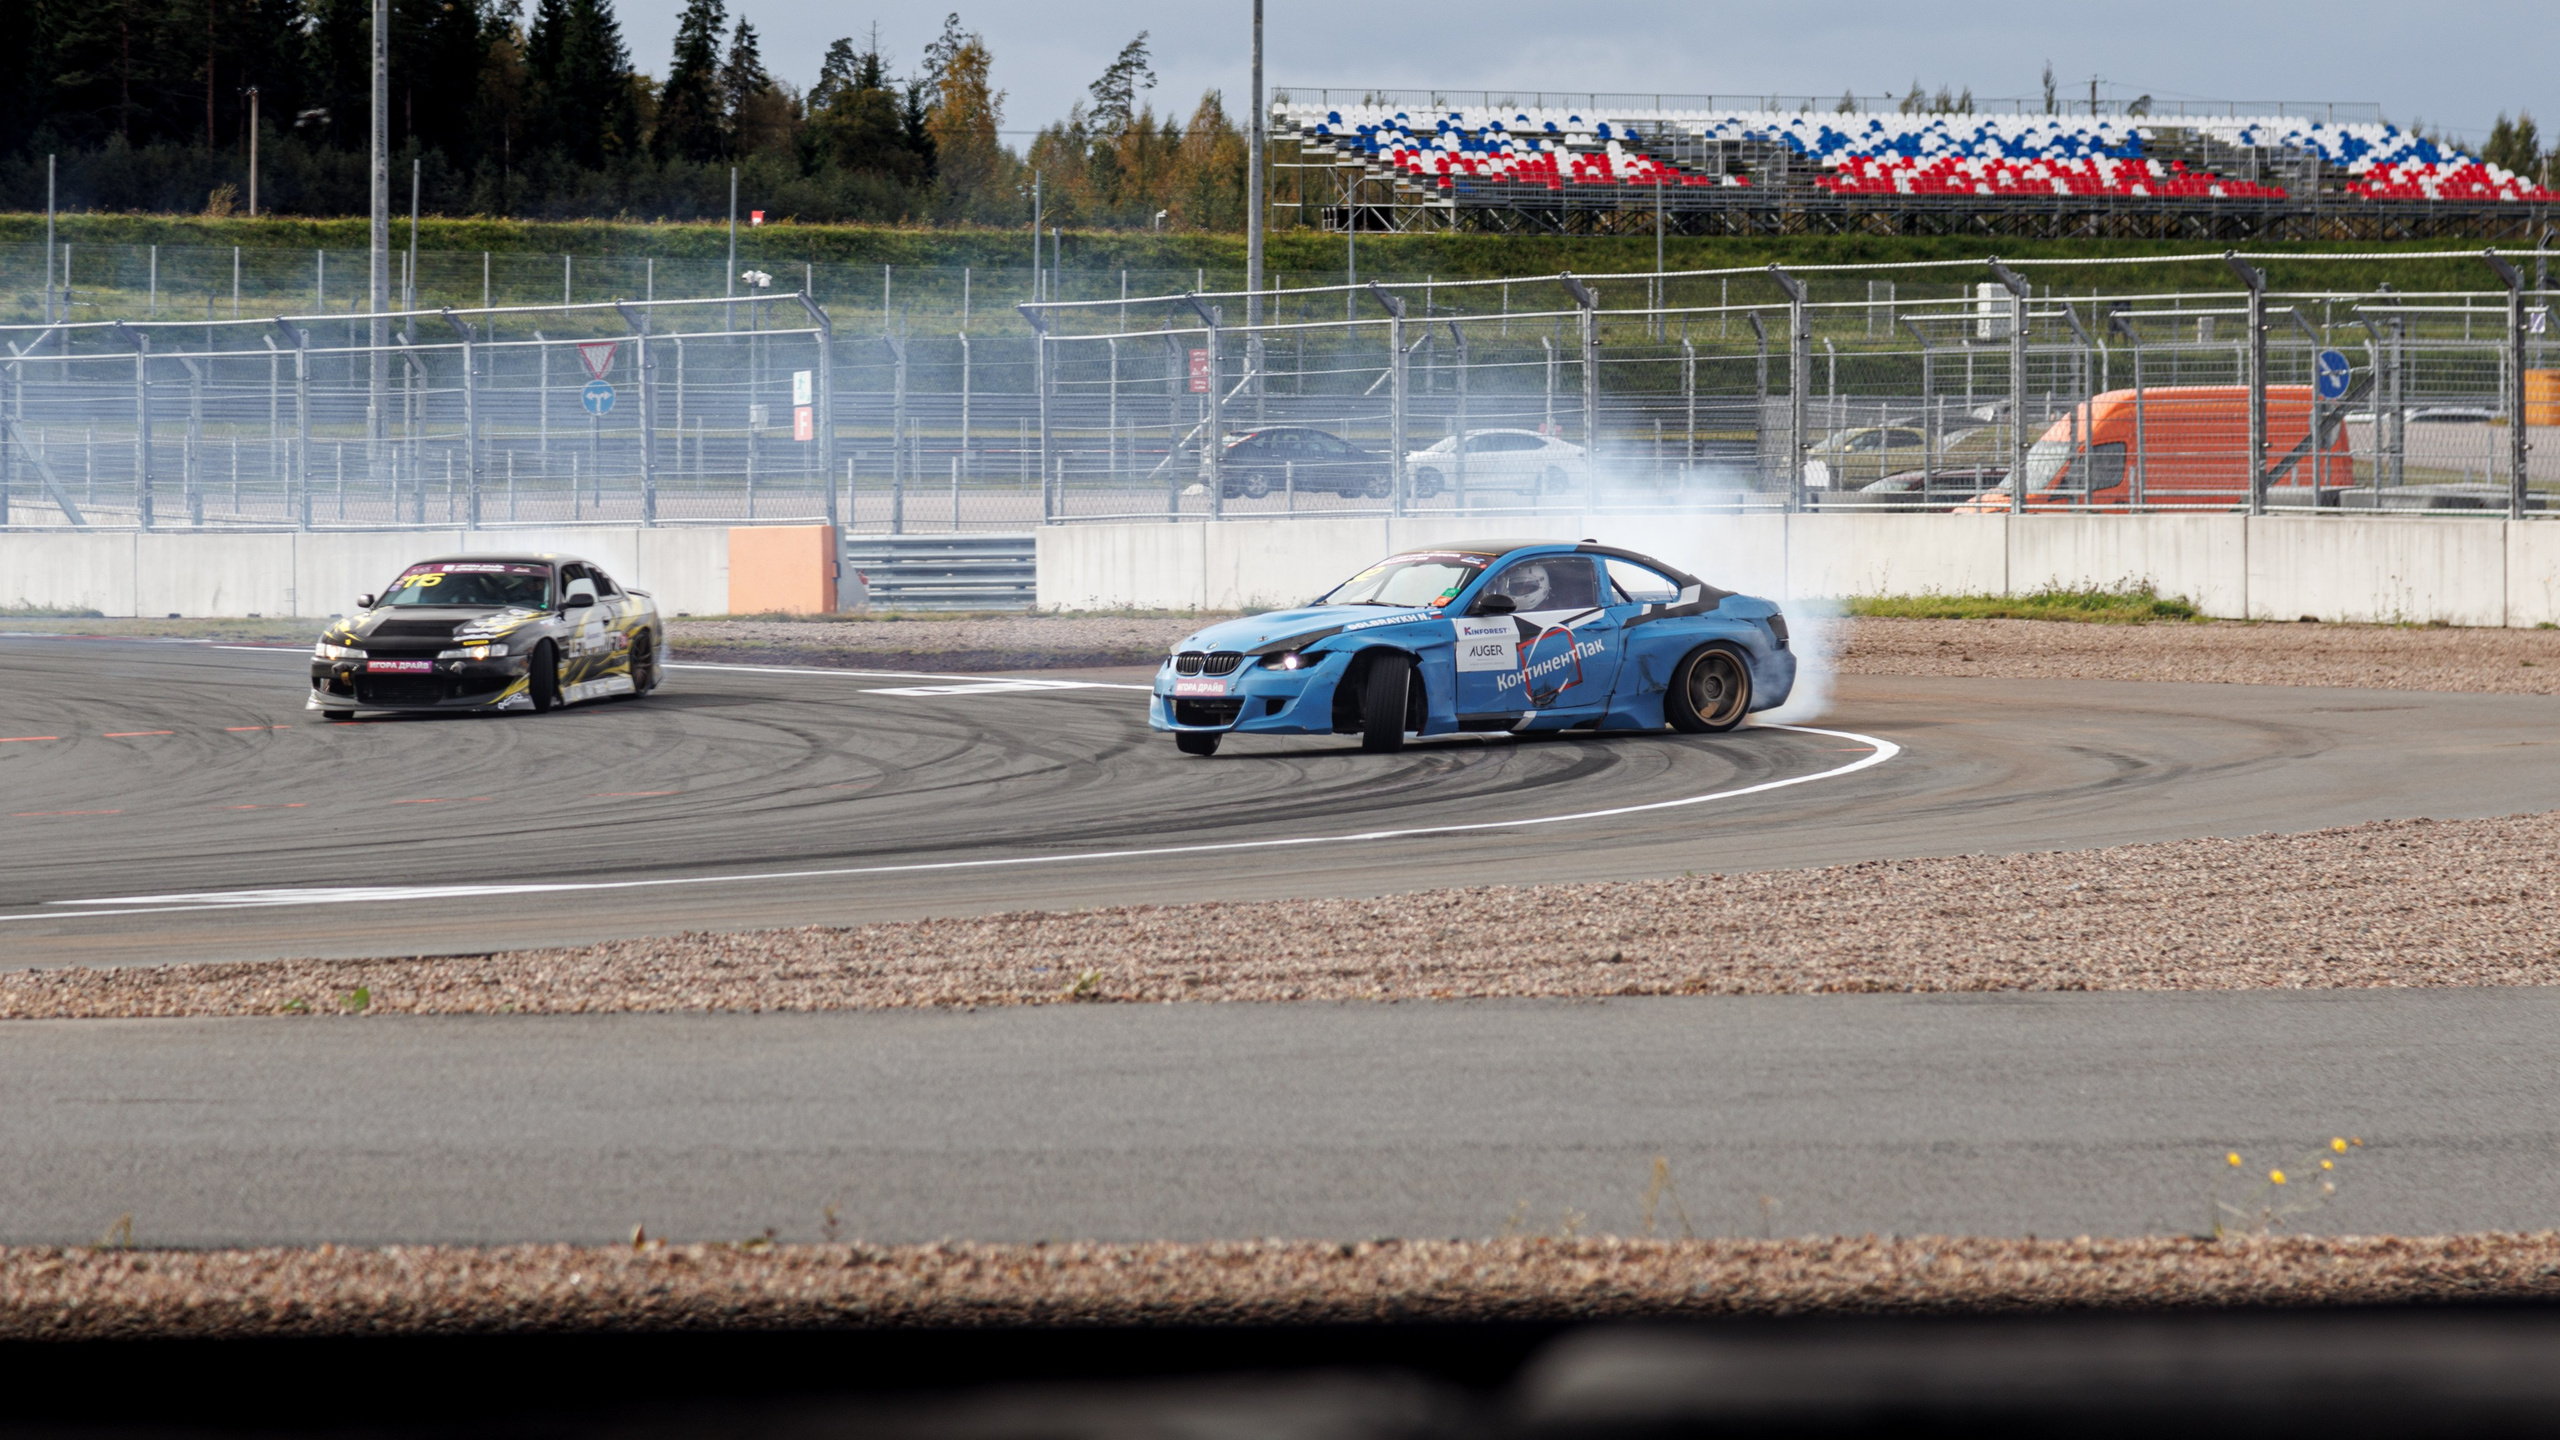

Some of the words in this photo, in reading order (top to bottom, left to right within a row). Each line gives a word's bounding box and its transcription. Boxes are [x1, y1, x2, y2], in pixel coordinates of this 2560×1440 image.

[800, 411, 808, 436] F
[1464, 626, 1508, 636] KINFOREST
[1469, 644, 1504, 657] AUGER
[369, 660, 397, 669] ИГОРА
[398, 660, 429, 670] ДРАЙВ
[1496, 638, 1606, 692] КонтинентПак
[1177, 683, 1197, 692] ИГОРА
[1198, 682, 1223, 692] ДРАЙВ
